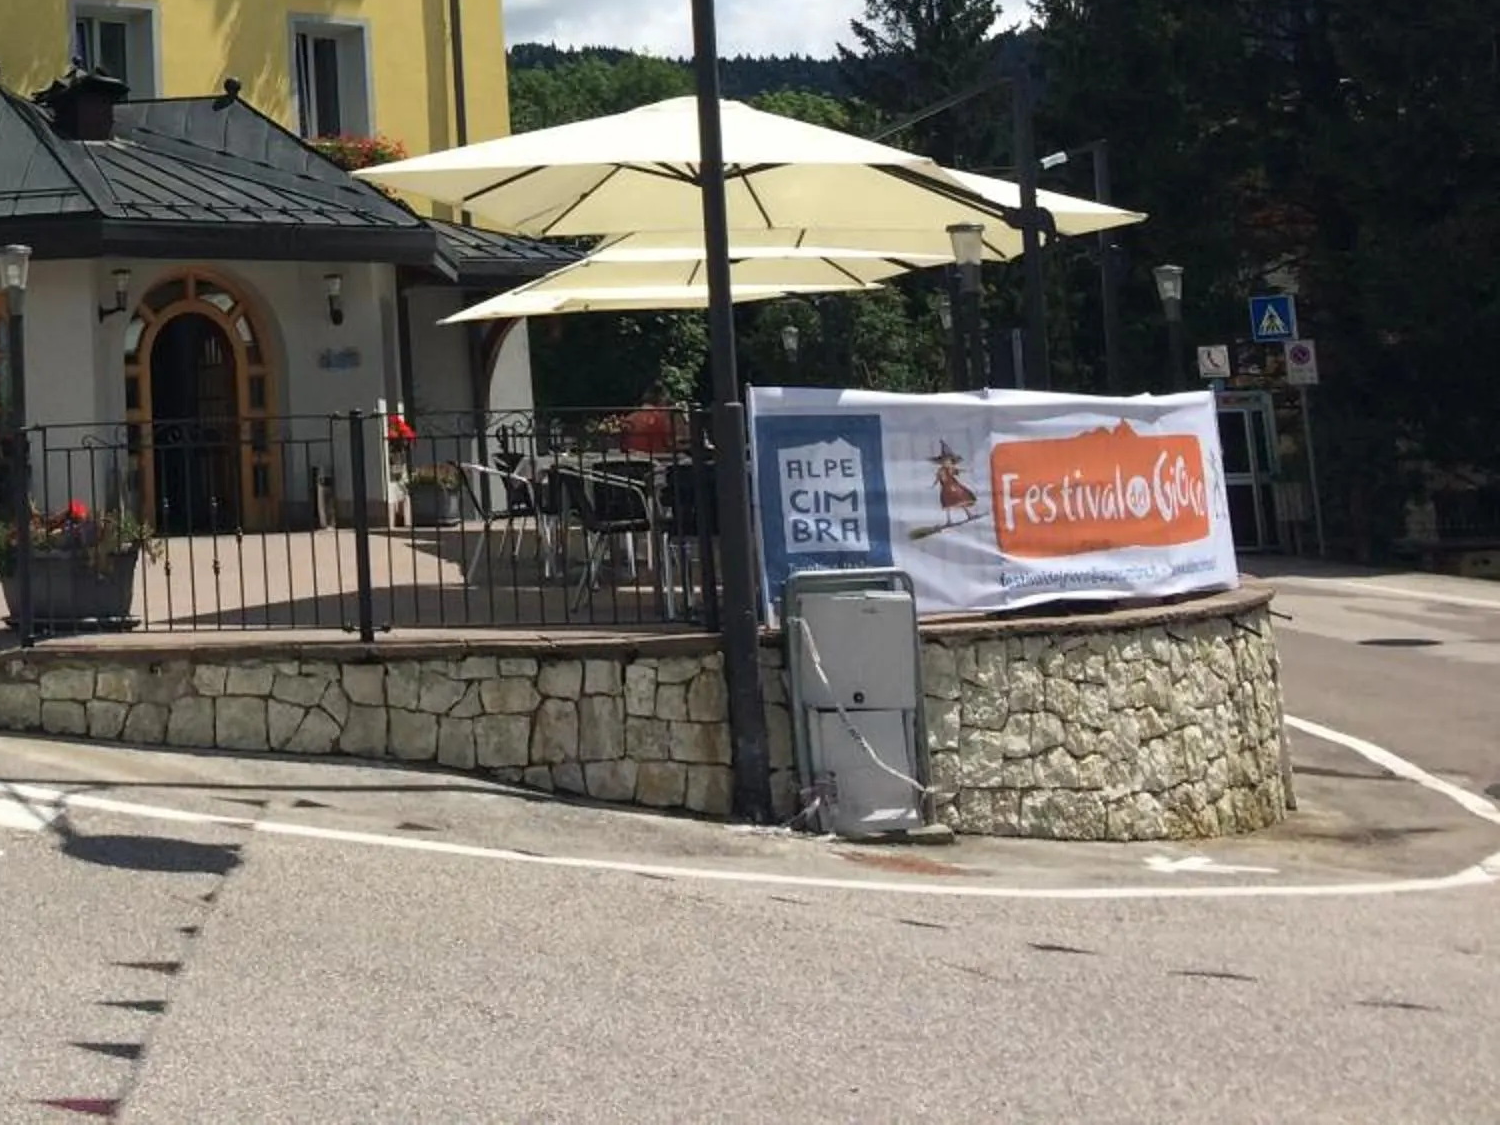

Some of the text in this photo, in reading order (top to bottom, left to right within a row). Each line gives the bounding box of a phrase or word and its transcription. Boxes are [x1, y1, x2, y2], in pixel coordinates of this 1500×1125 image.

[785, 458, 855, 480] ALPE
[789, 488, 859, 514] CIM
[1001, 463, 1126, 532] Festival
[791, 517, 861, 543] BRA
